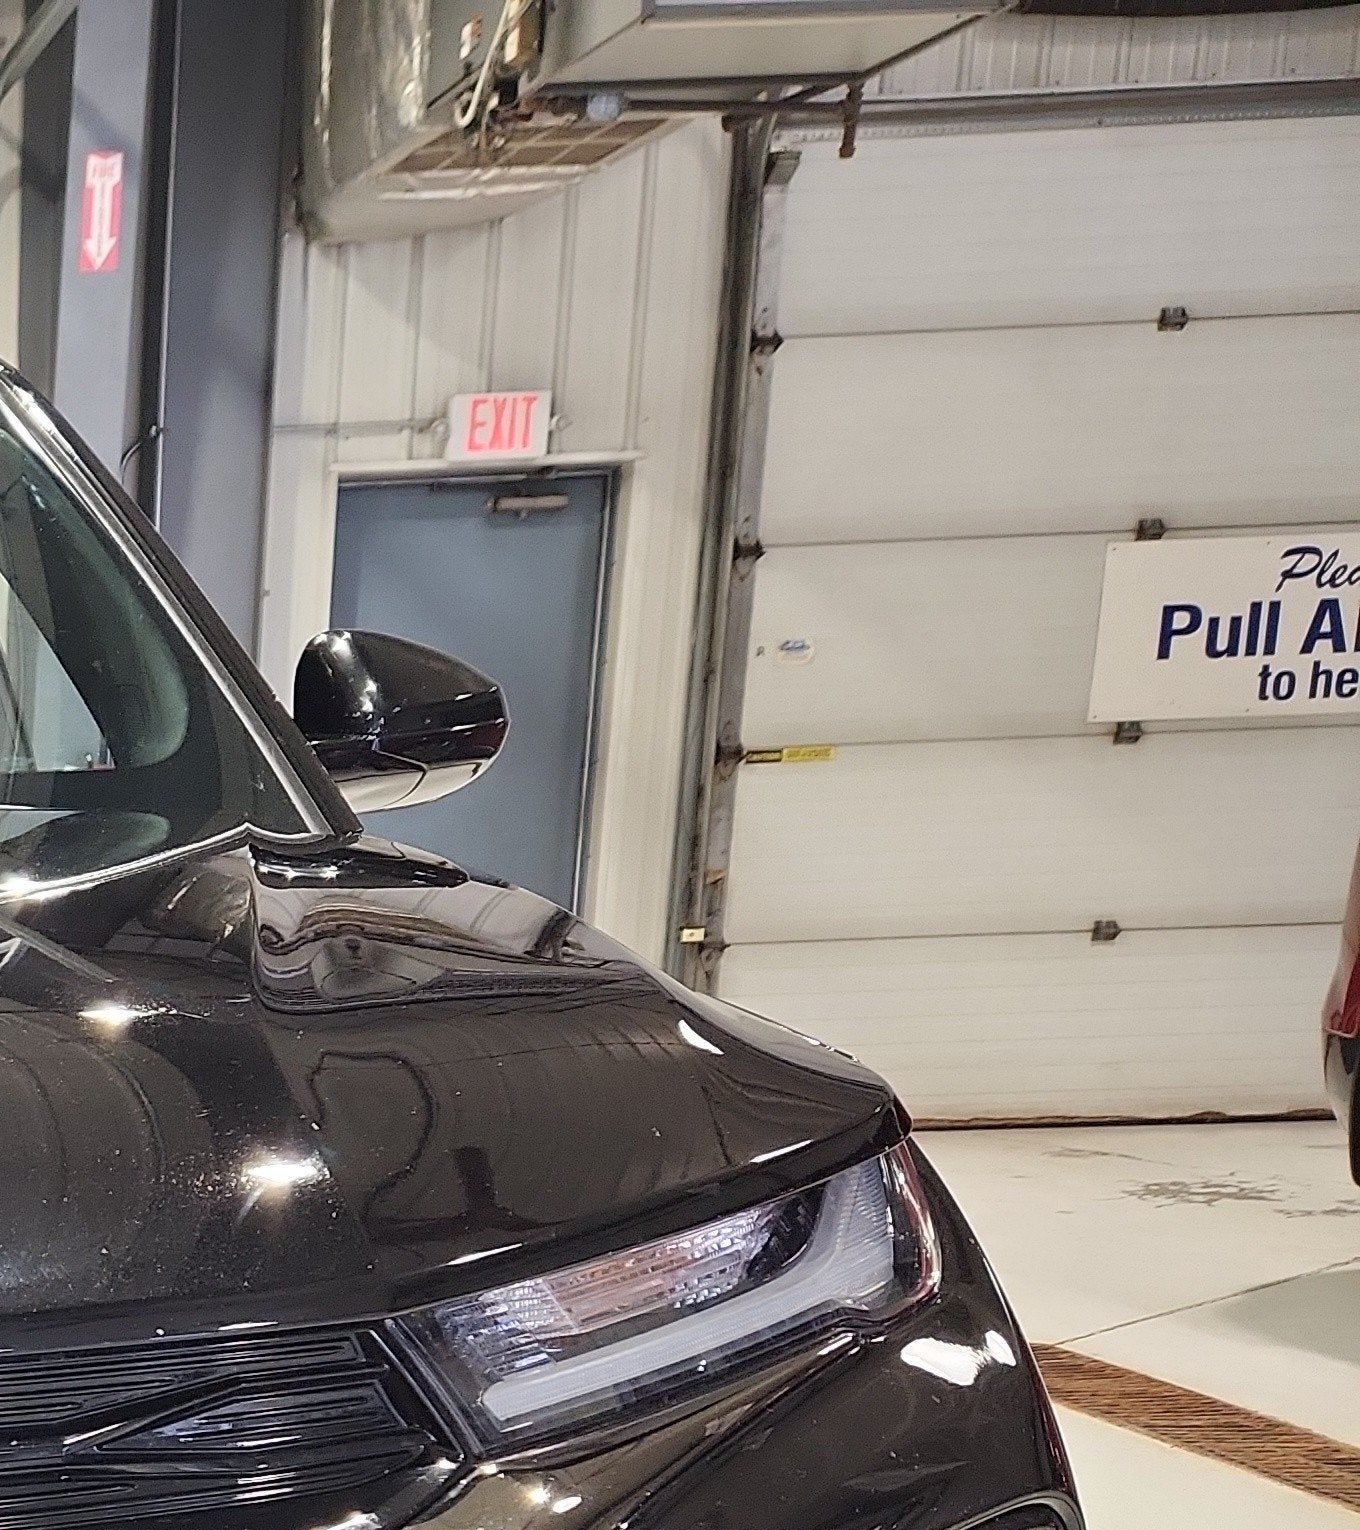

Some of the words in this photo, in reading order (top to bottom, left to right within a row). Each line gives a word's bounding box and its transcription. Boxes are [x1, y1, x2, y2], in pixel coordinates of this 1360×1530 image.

[467, 395, 538, 451] EXIT
[1156, 600, 1281, 660] Pull
[1298, 597, 1360, 655] A
[1258, 664, 1296, 701] to
